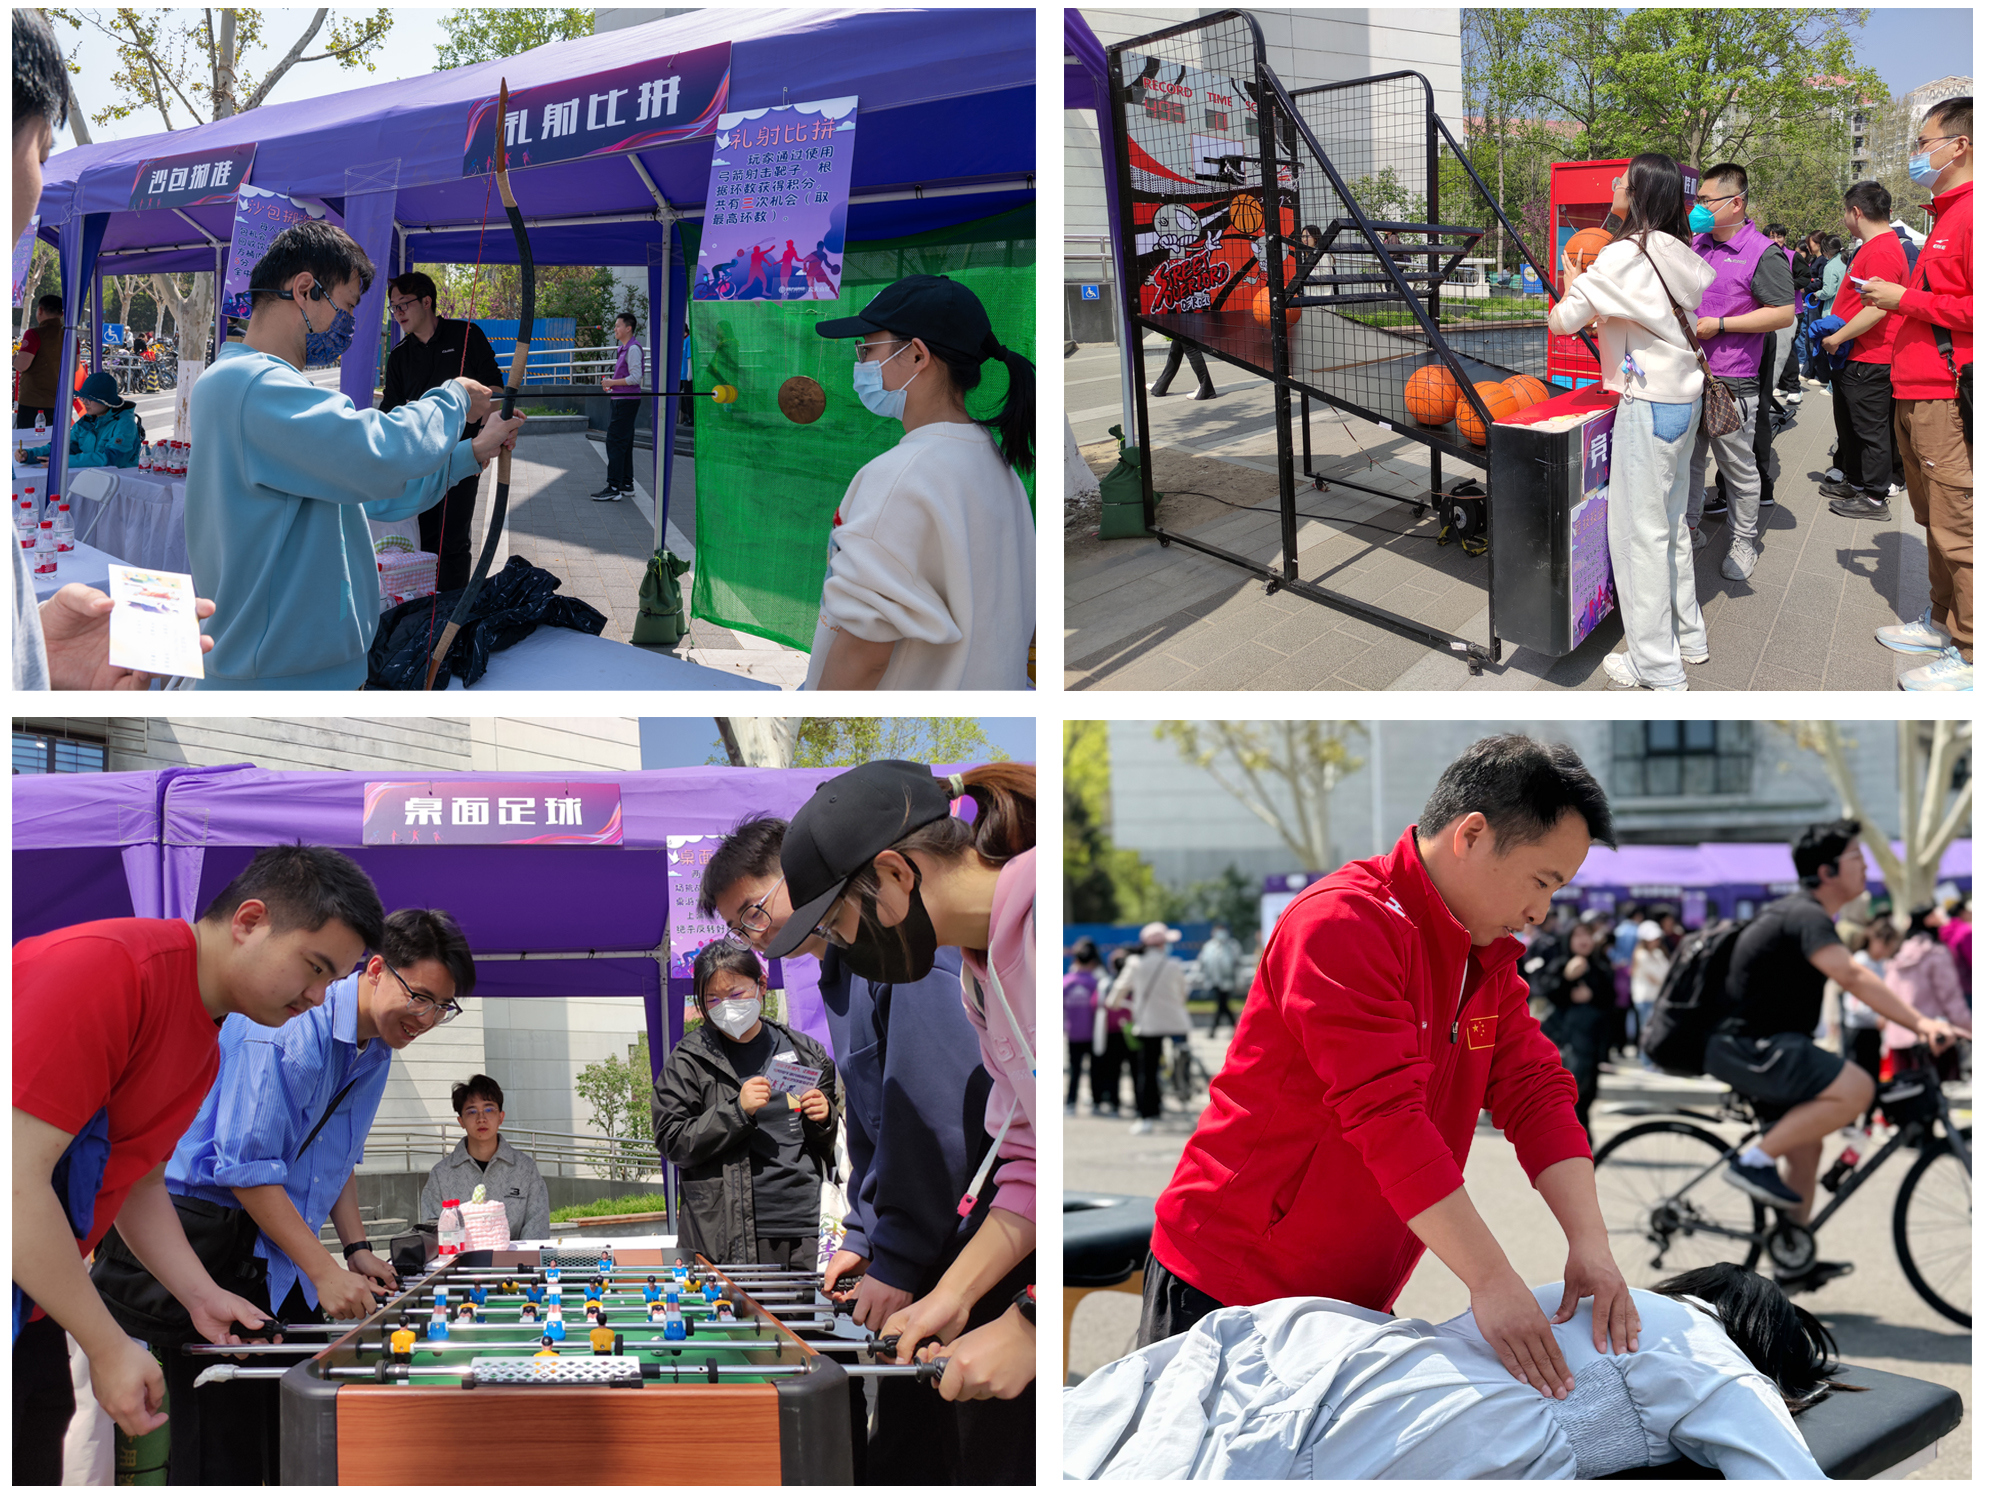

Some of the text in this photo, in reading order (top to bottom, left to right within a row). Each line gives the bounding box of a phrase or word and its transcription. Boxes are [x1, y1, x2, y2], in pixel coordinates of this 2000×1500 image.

[1143, 78, 1193, 98] RECORD
[1206, 92, 1233, 107] TIME
[504, 75, 681, 147] 礼射比拼
[730, 117, 836, 150] 礼射比拼
[747, 145, 834, 166] 玩家通过使用
[148, 160, 233, 194] 沙包掷准
[404, 797, 583, 826] 桌面足球
[676, 924, 731, 934] 绝杀反转好
